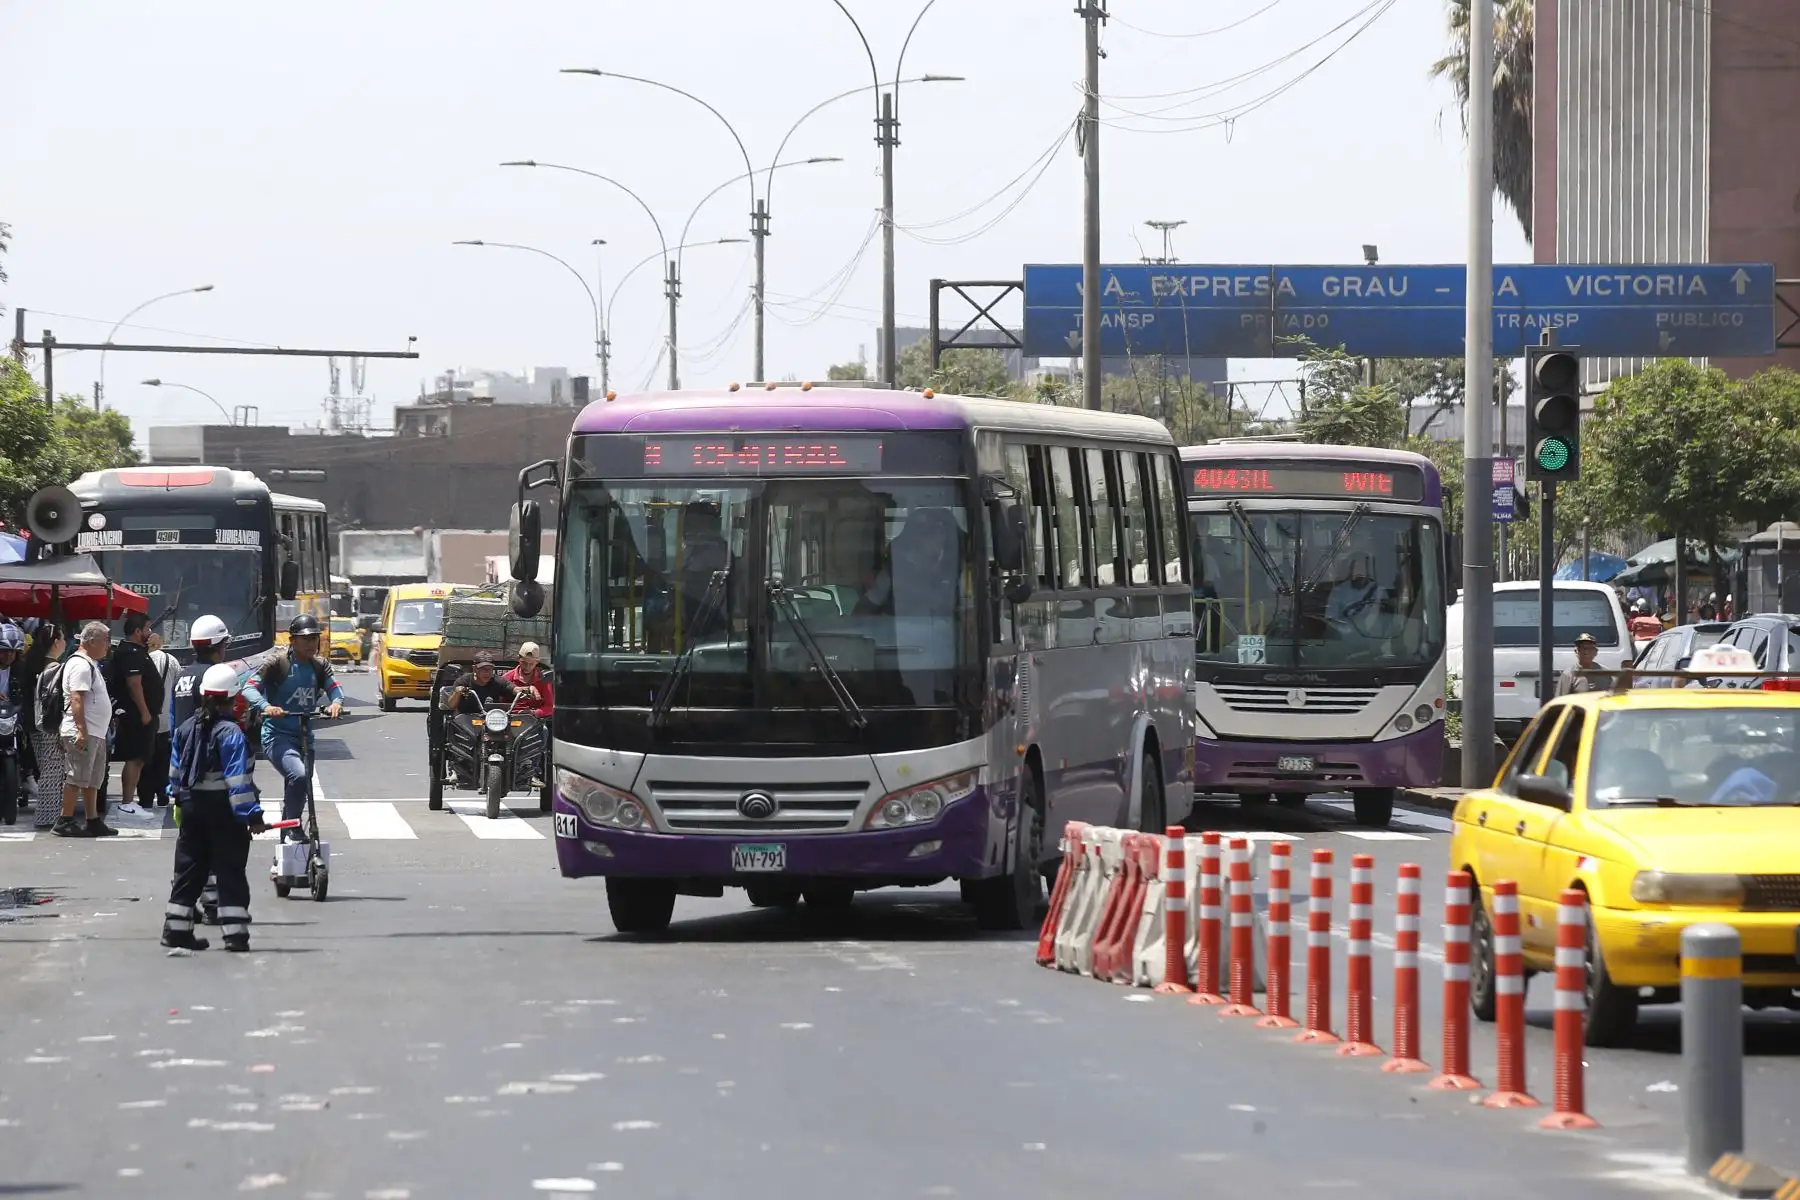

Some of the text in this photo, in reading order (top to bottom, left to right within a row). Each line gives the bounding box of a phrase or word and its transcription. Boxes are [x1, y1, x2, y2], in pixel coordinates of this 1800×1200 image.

[1150, 275, 1296, 297] EXPRESA
[1322, 276, 1408, 297] GRAU
[1565, 275, 1707, 297] VICTORIA
[1073, 313, 1155, 329] TANSP
[1496, 312, 1744, 328] TRANSP PUBLICO
[1240, 649, 1264, 664] 12
[285, 687, 316, 705] AXA
[556, 815, 577, 838] 811
[733, 851, 784, 868] AYY-791
